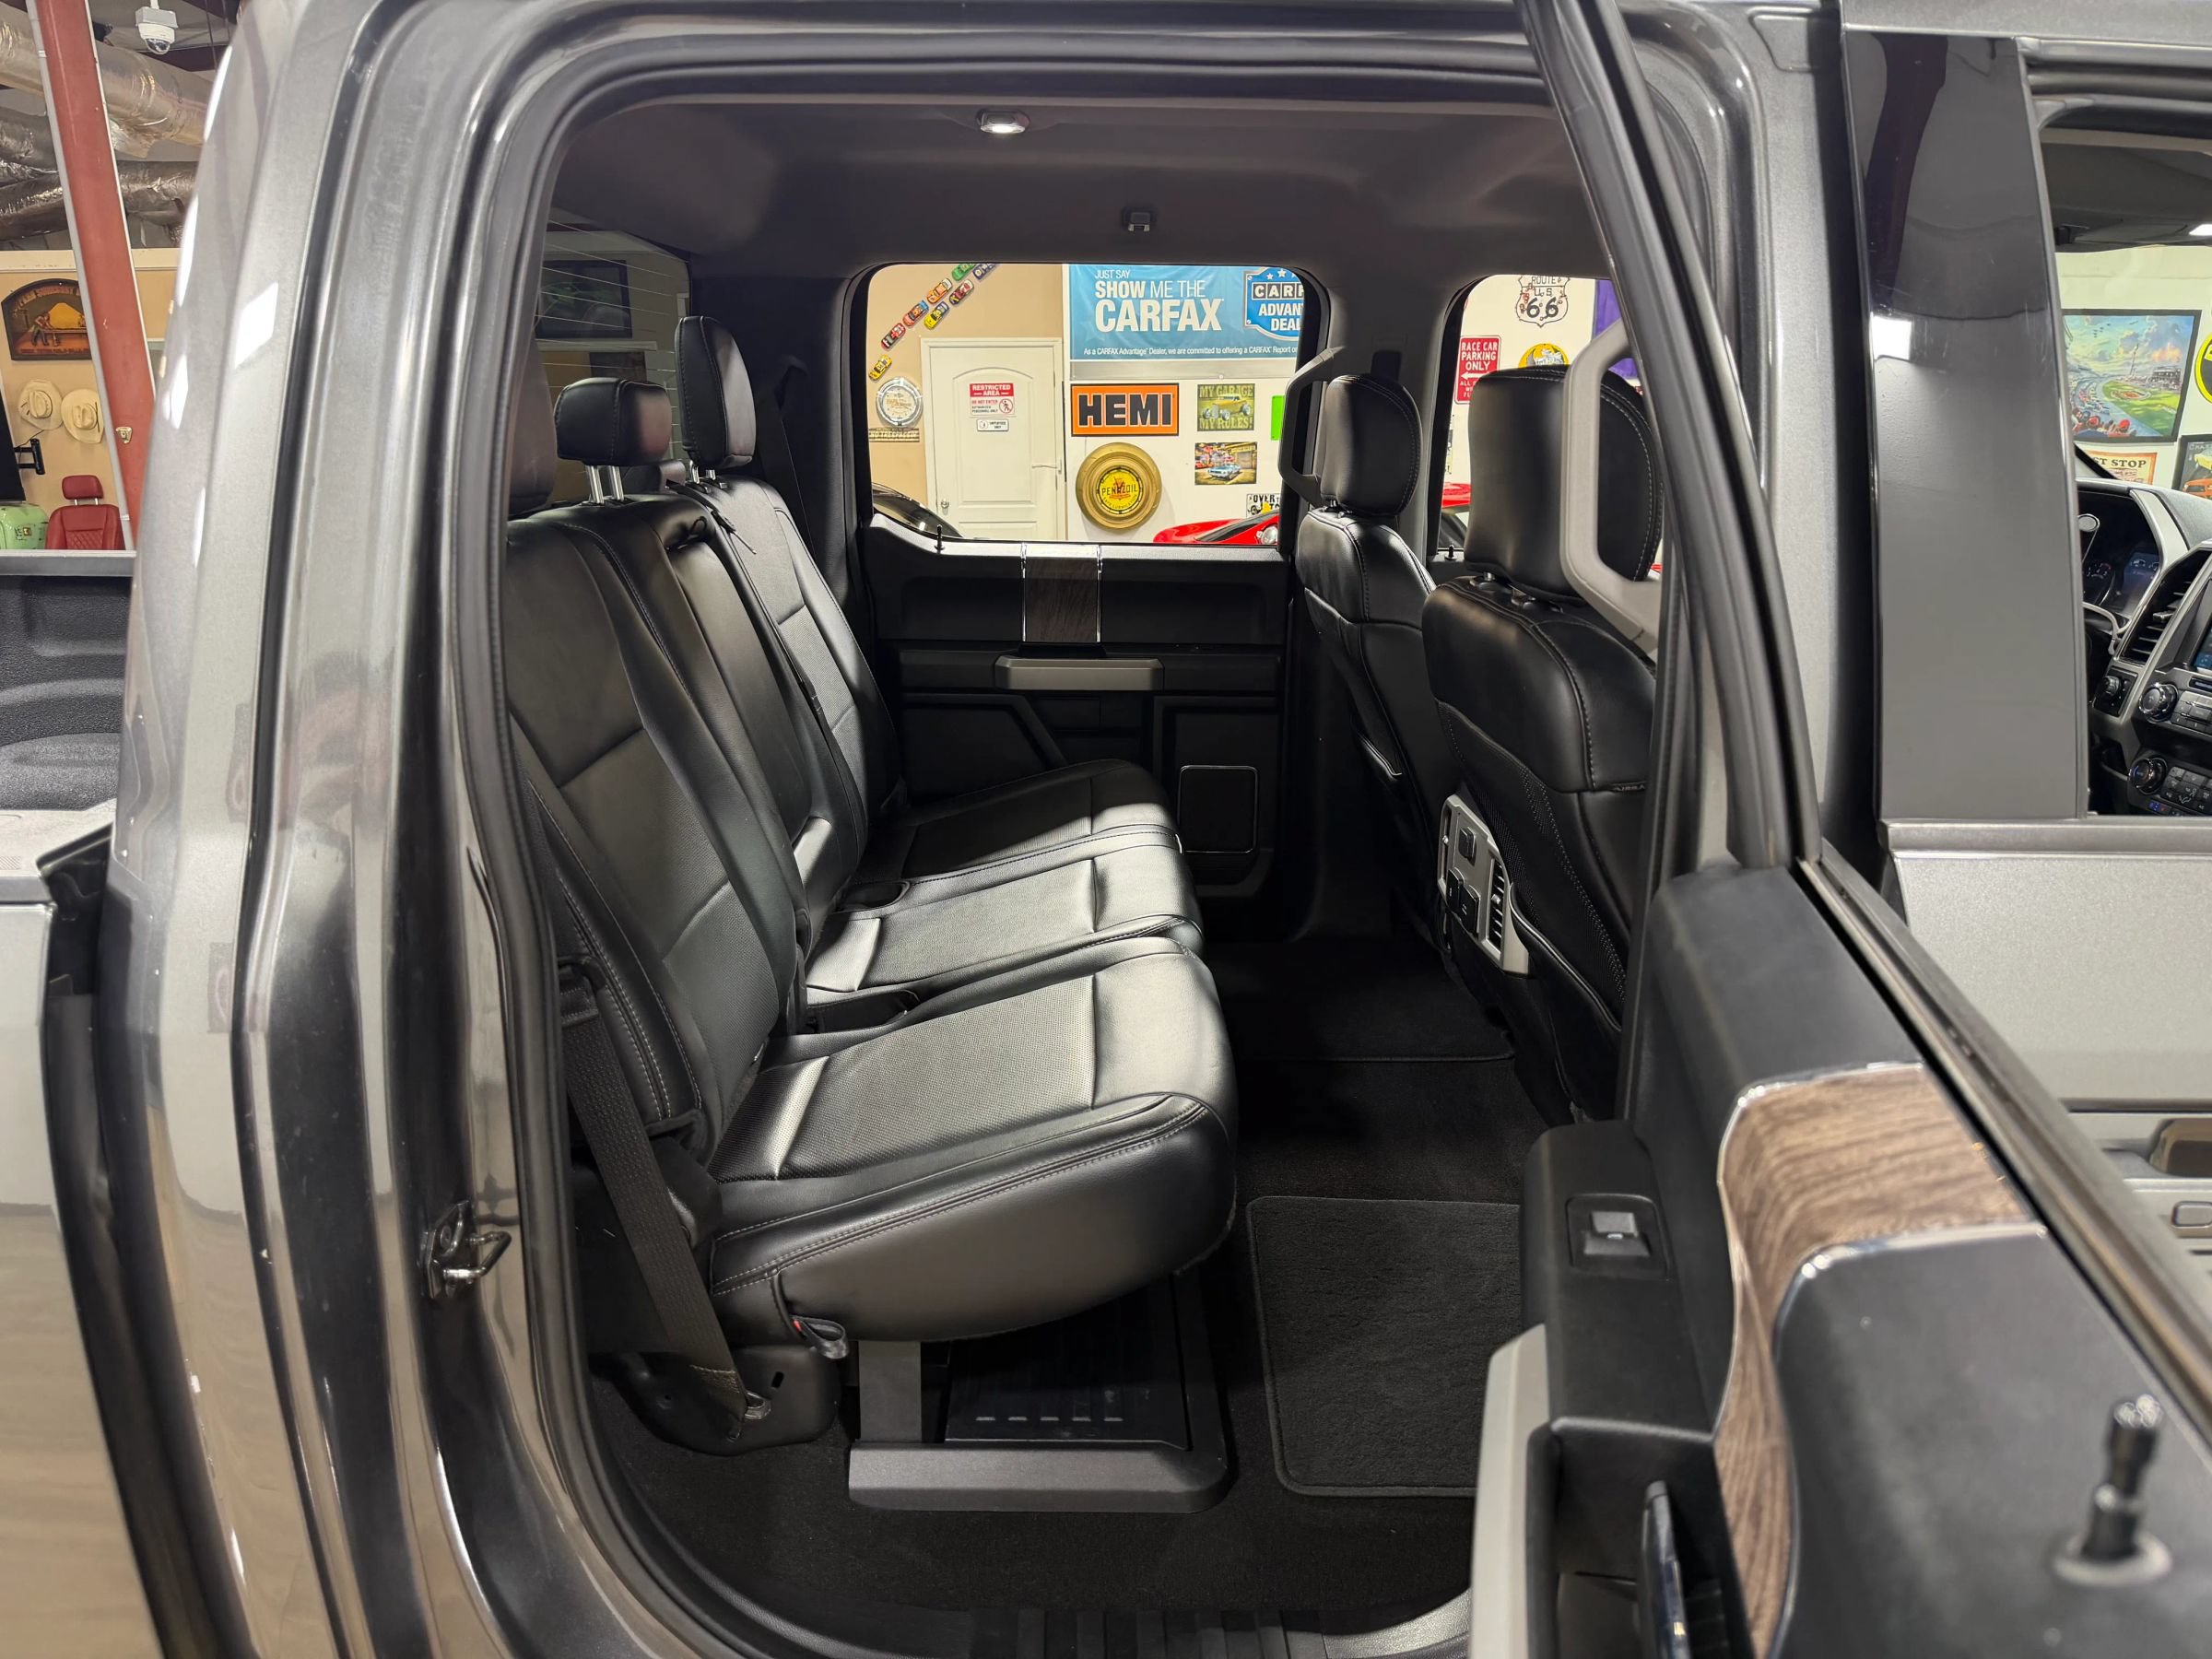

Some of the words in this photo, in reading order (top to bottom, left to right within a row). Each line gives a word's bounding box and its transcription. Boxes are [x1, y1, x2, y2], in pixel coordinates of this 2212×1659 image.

[1094, 269, 1114, 279] JUST
[1115, 269, 1130, 278] SAY
[1531, 276, 1557, 285] ROUTE
[1095, 280, 1145, 299] SHOW
[1150, 280, 1173, 298] ME
[1179, 280, 1206, 298] THE
[1526, 297, 1559, 319] 66
[1095, 299, 1223, 333] CARFAX
[1148, 347, 1168, 356] Dealer,
[1186, 347, 1215, 355] committed
[1222, 347, 1243, 355] offering
[1248, 346, 1271, 354] CARFAX
[1272, 346, 1291, 355] Report
[1461, 342, 1481, 351] RACE
[1483, 341, 1498, 351] CAR
[1461, 352, 1497, 361] PARKING
[1465, 361, 1490, 371] ONLY
[1199, 386, 1215, 397] MY
[1217, 384, 1254, 397] GARAGE
[1077, 393, 1173, 428] HEMI
[1199, 418, 1216, 429] MY
[1217, 417, 1253, 429] RULES!
[2111, 459, 2147, 468] STOP
[1101, 483, 1138, 497] PENNZOIL
[1253, 494, 1275, 503] OVER
